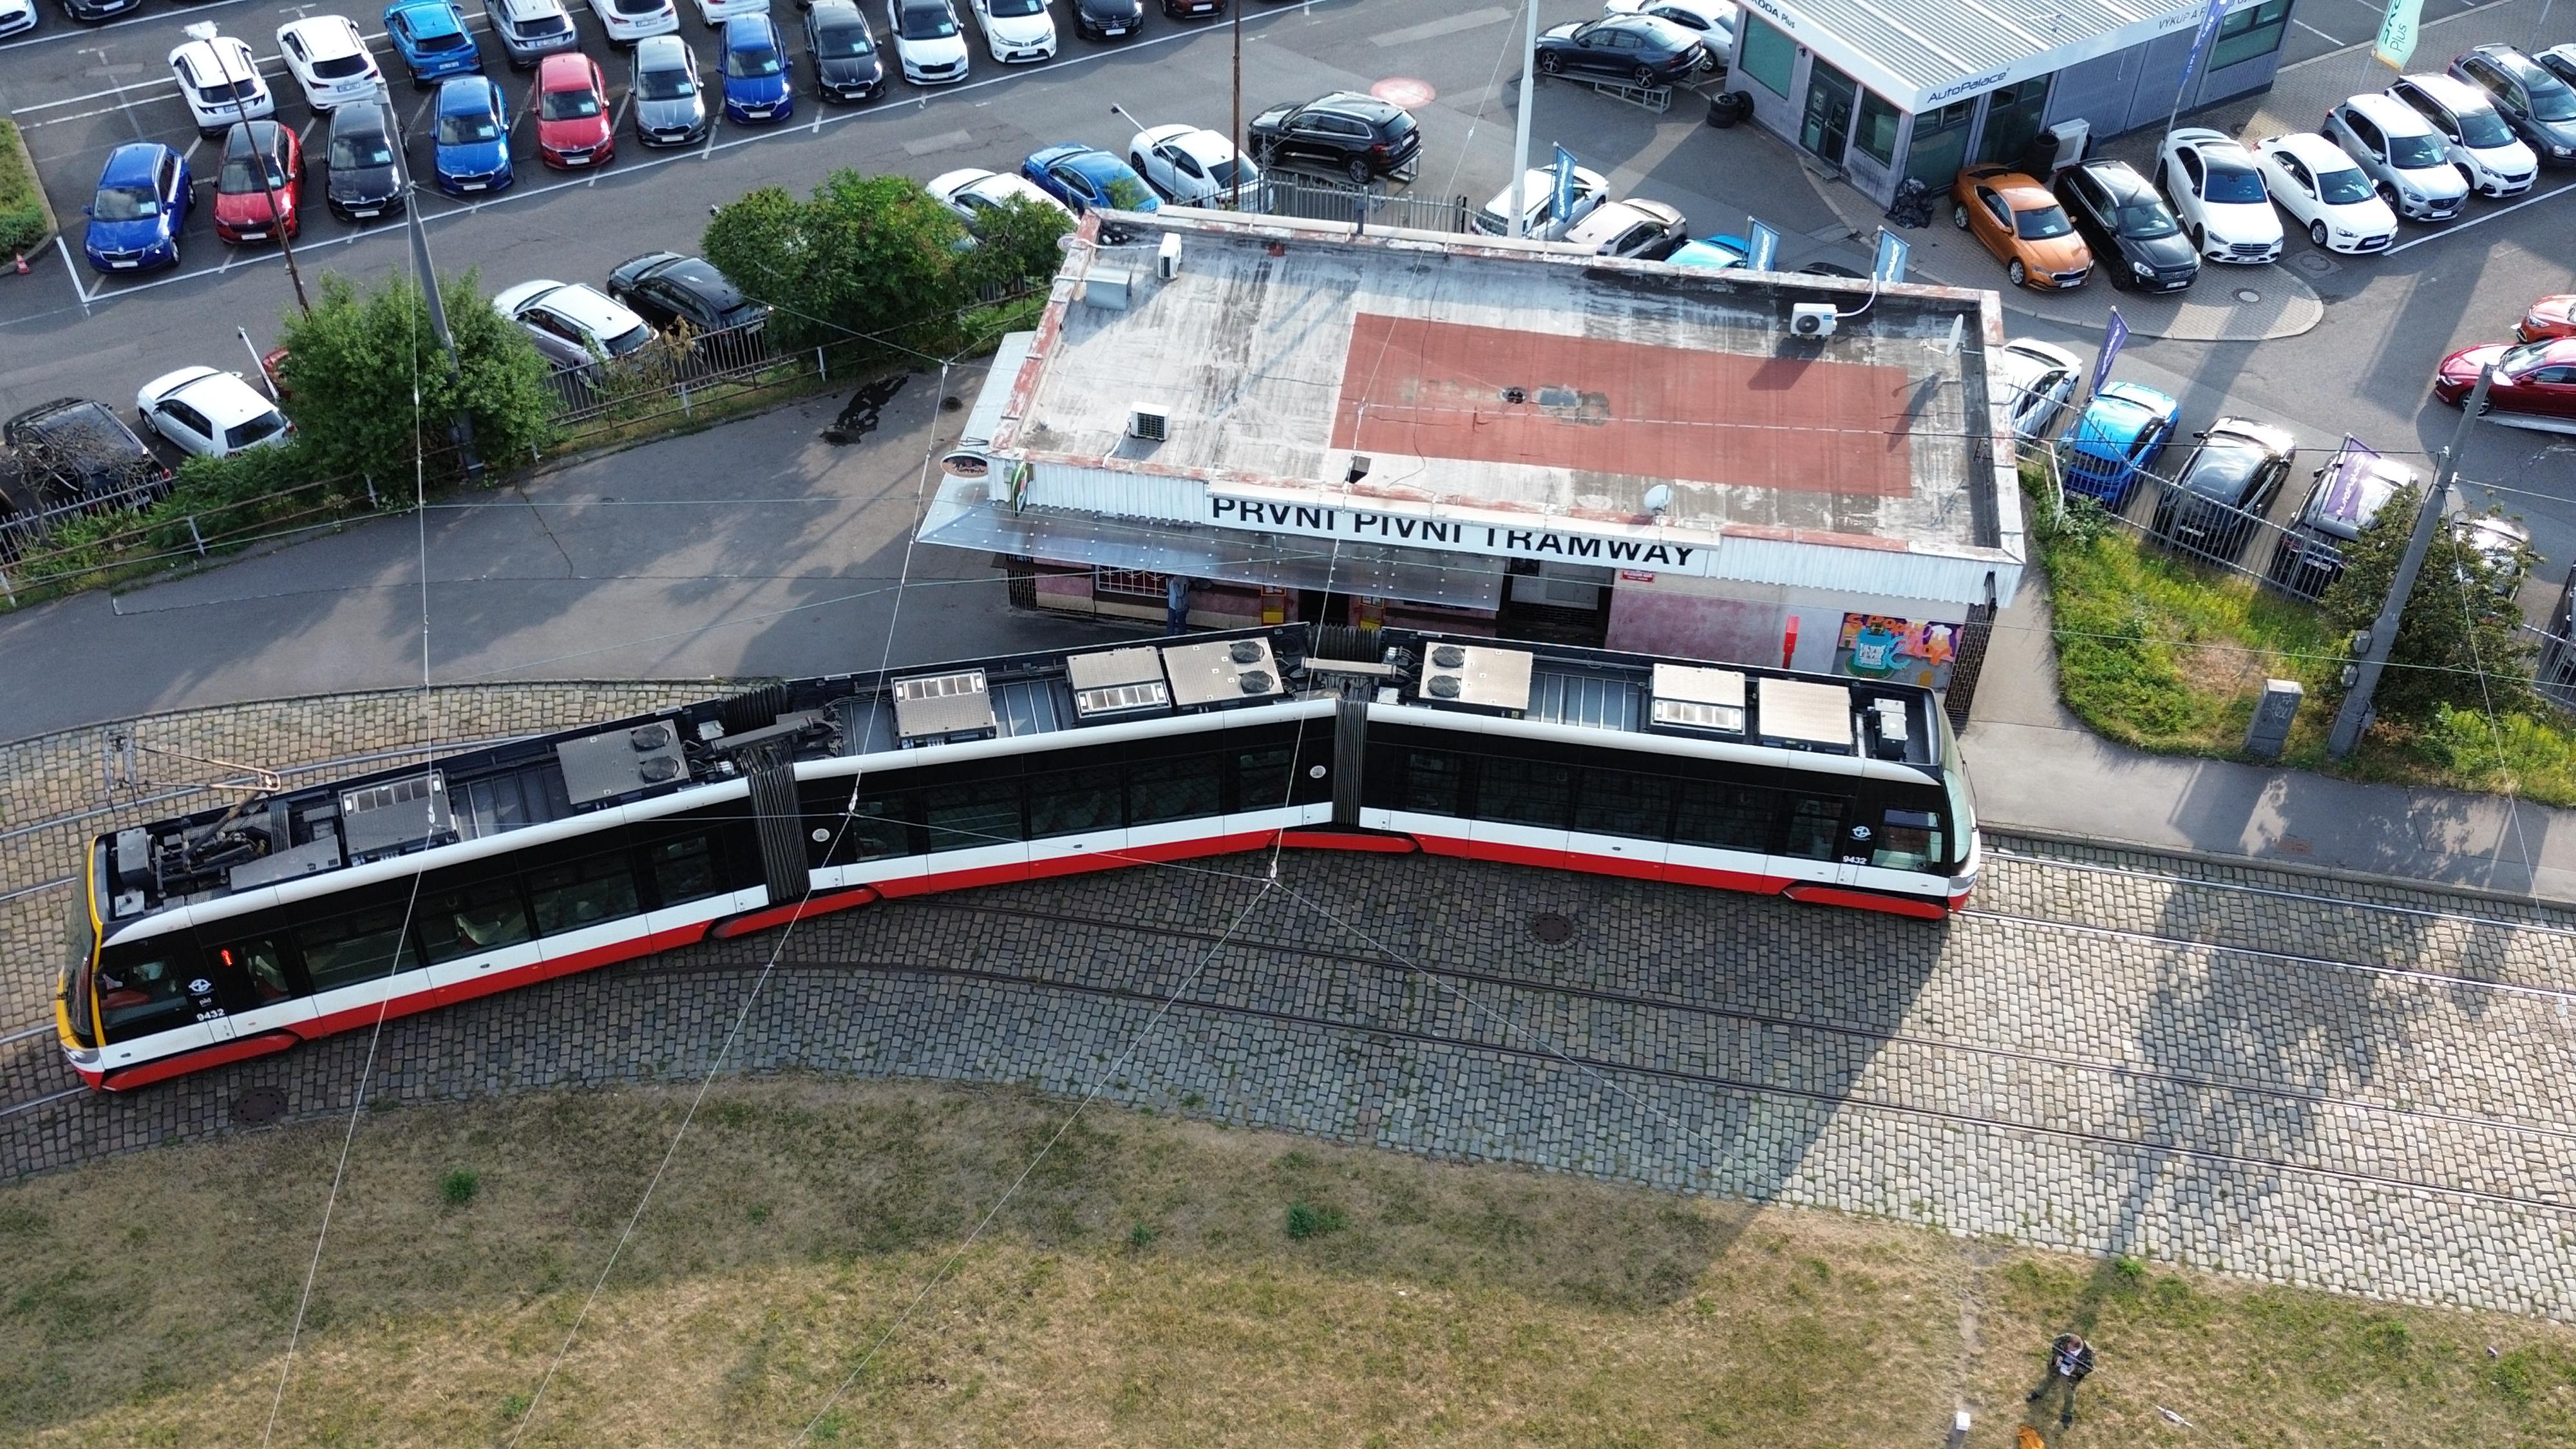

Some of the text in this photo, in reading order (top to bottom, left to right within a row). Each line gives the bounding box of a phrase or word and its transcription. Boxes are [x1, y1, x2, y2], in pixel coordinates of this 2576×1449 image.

[1781, 13, 1795, 29] Plus
[2191, 9, 2197, 19] A
[2389, 23, 2407, 53] Plus
[1487, 528, 1694, 566] TRAMWAY
[1842, 855, 1867, 864] 9432
[196, 1009, 225, 1021] 9432
